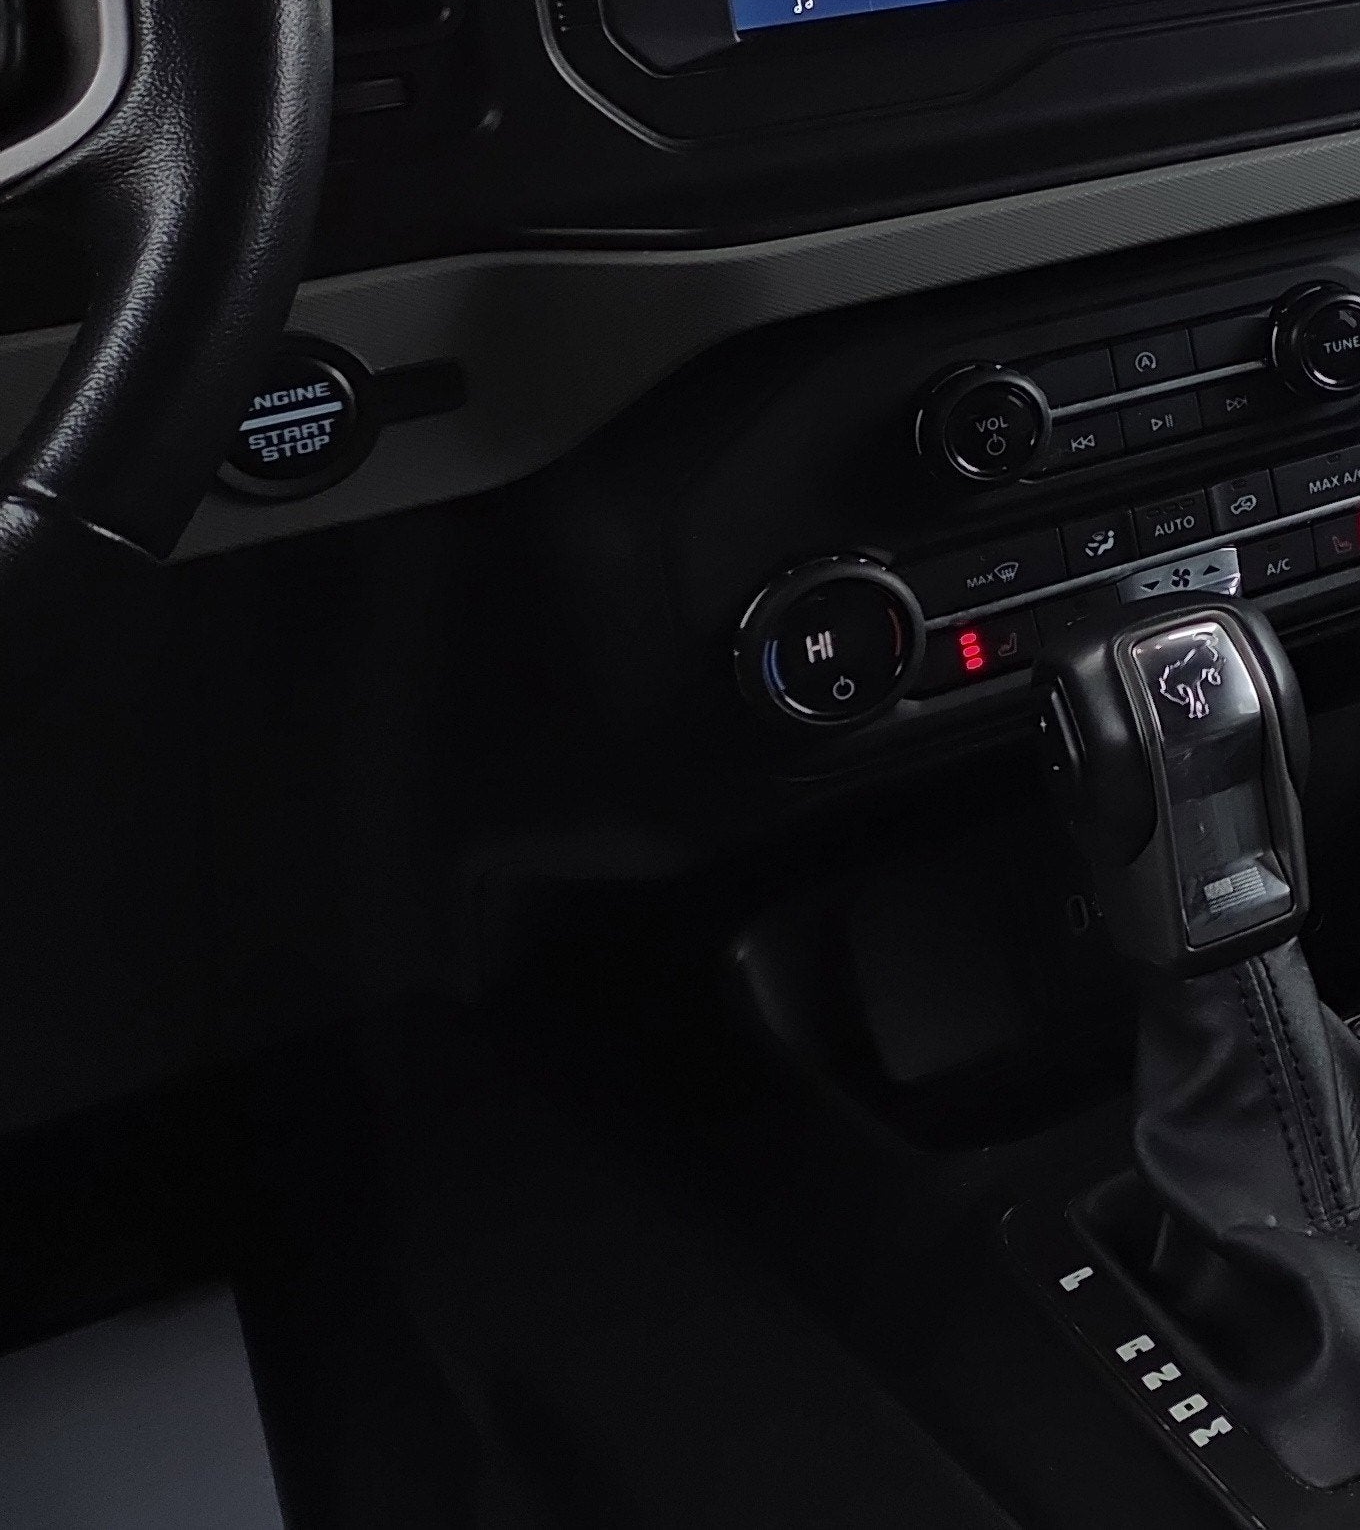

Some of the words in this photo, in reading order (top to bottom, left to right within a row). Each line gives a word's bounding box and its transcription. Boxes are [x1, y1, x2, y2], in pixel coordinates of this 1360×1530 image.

[1323, 335, 1360, 354] TUNE
[250, 382, 331, 411] NGINE
[248, 418, 335, 450] START
[975, 415, 1008, 433] VOL
[262, 434, 331, 462] STOP
[1308, 476, 1340, 494] MAX
[1154, 515, 1195, 537] AUTO
[966, 572, 995, 589] MAX
[1266, 558, 1292, 576] A/C
[805, 630, 834, 664] HI
[1059, 1266, 1094, 1292] P
[1141, 1362, 1182, 1391] N
[1168, 1393, 1209, 1423] D
[1188, 1415, 1234, 1448] M
